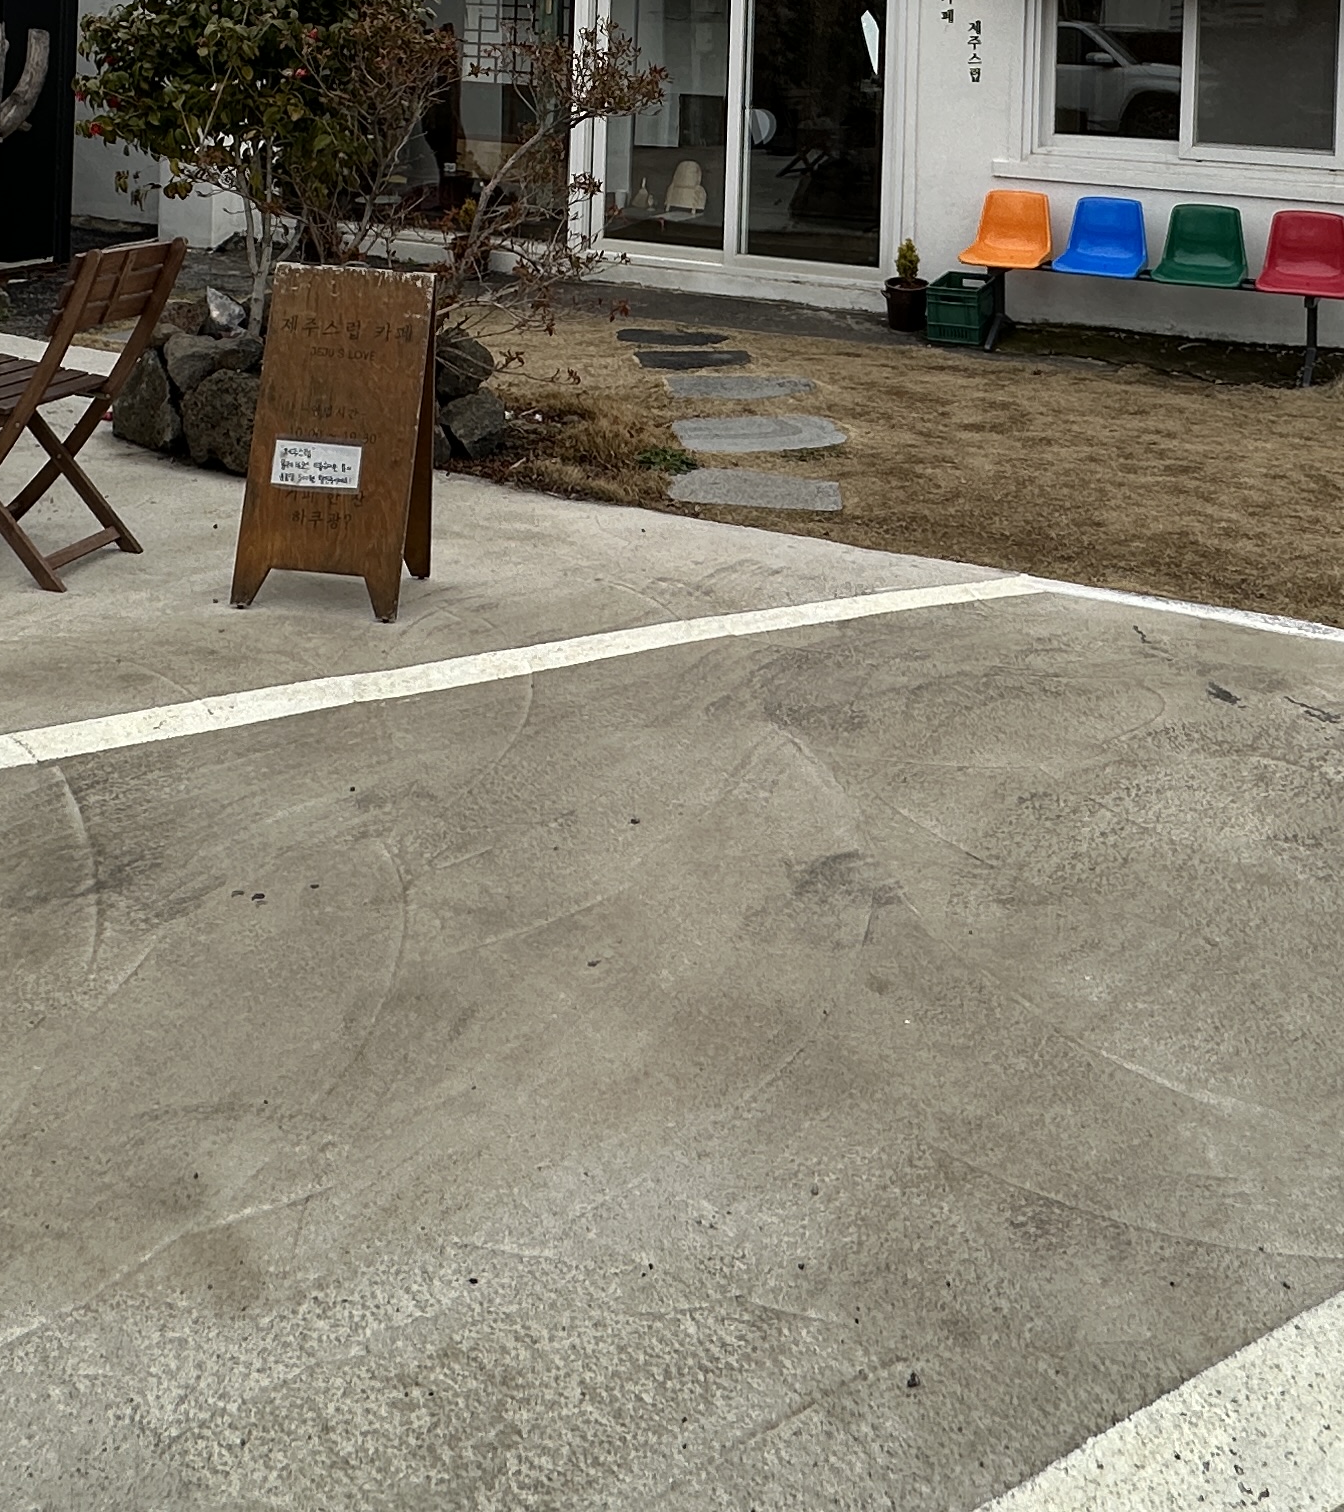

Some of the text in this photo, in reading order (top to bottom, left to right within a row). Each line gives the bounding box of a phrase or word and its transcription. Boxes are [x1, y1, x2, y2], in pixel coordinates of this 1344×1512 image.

[967, 19, 982, 83] 제주스럽
[281, 314, 413, 343] 제주스럽 카페
[348, 349, 376, 361] LOVE
